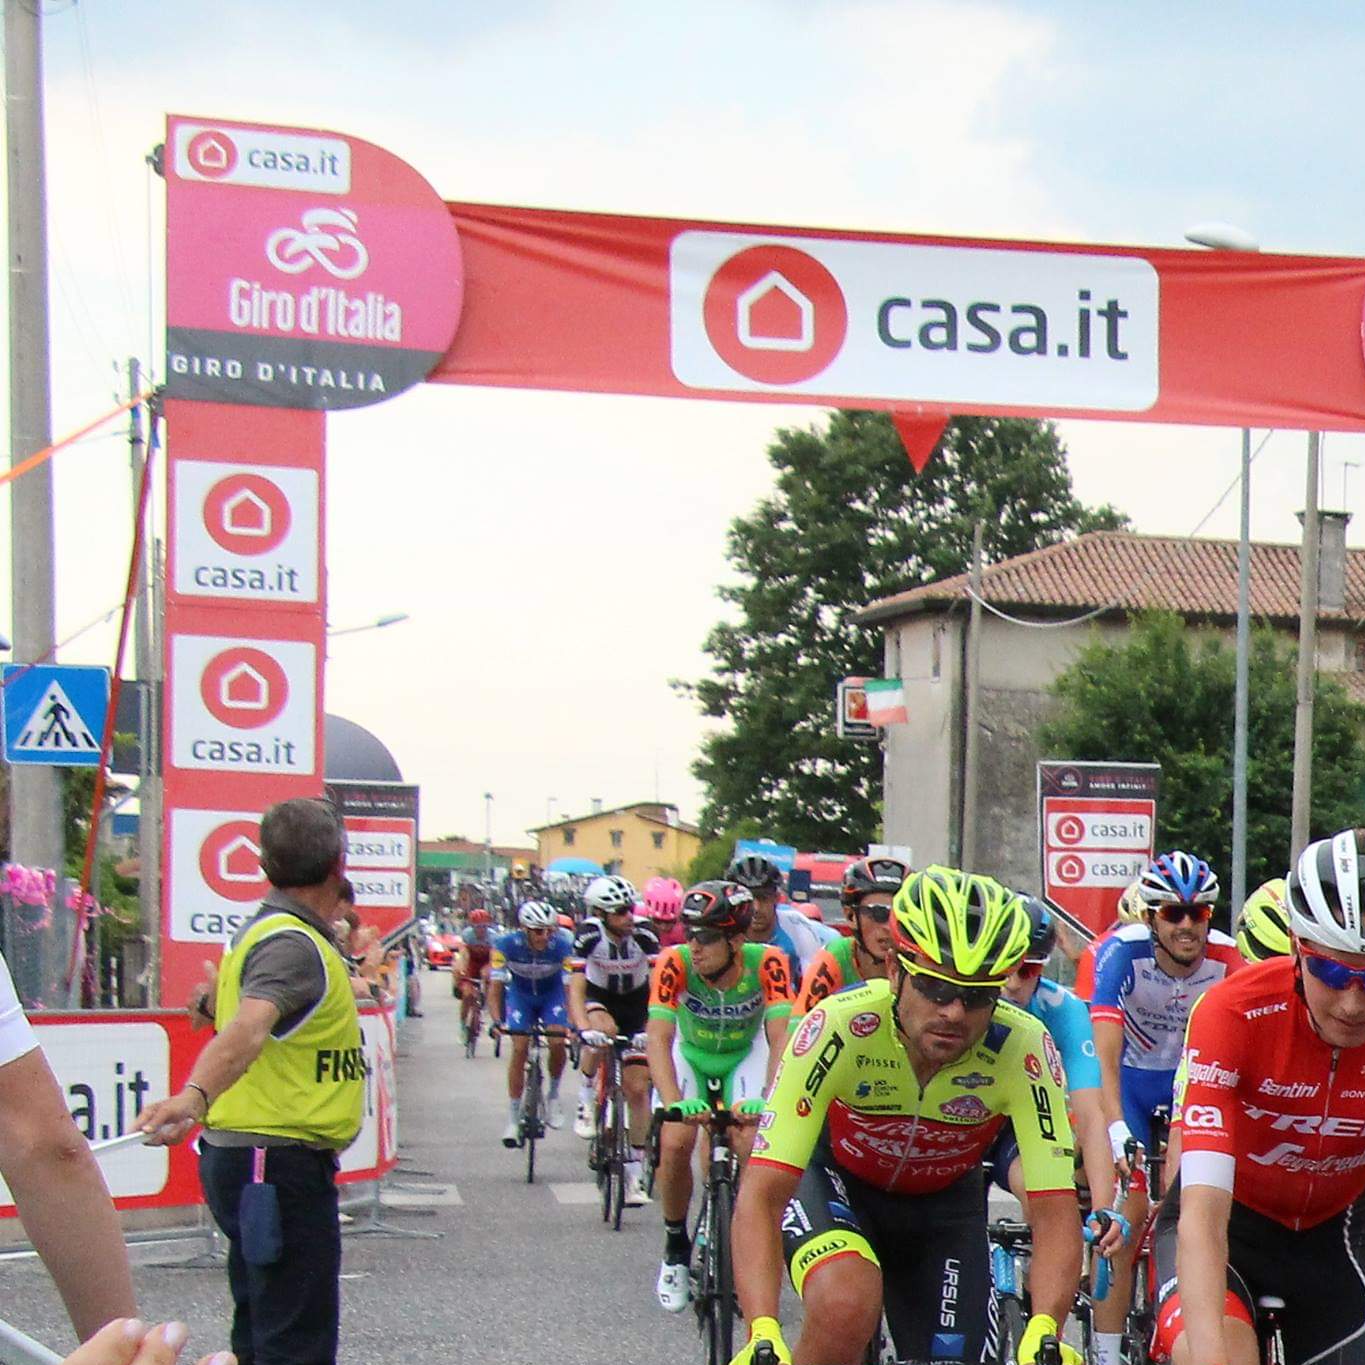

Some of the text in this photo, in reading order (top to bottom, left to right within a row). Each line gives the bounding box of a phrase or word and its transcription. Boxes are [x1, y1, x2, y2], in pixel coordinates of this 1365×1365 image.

[247, 145, 340, 178] casa.it
[231, 278, 402, 342] Giro d'Italia
[877, 288, 1129, 361] casa.it
[171, 353, 387, 393] GIRO D'ITALIA
[193, 562, 300, 595] casa.it
[192, 736, 296, 765] casa.it
[1090, 822, 1145, 838] casa.it
[1091, 860, 1143, 877] casa.it
[355, 879, 404, 895] asa.it
[658, 956, 681, 1003] CST
[763, 956, 789, 998] CST
[1243, 1002, 1288, 1021] TREK
[805, 1031, 846, 1098] SIDI
[1257, 1077, 1322, 1098] Santini
[1031, 1083, 1057, 1142] SIDI
[1184, 1103, 1223, 1129] ca
[939, 1257, 960, 1329] URSUS
